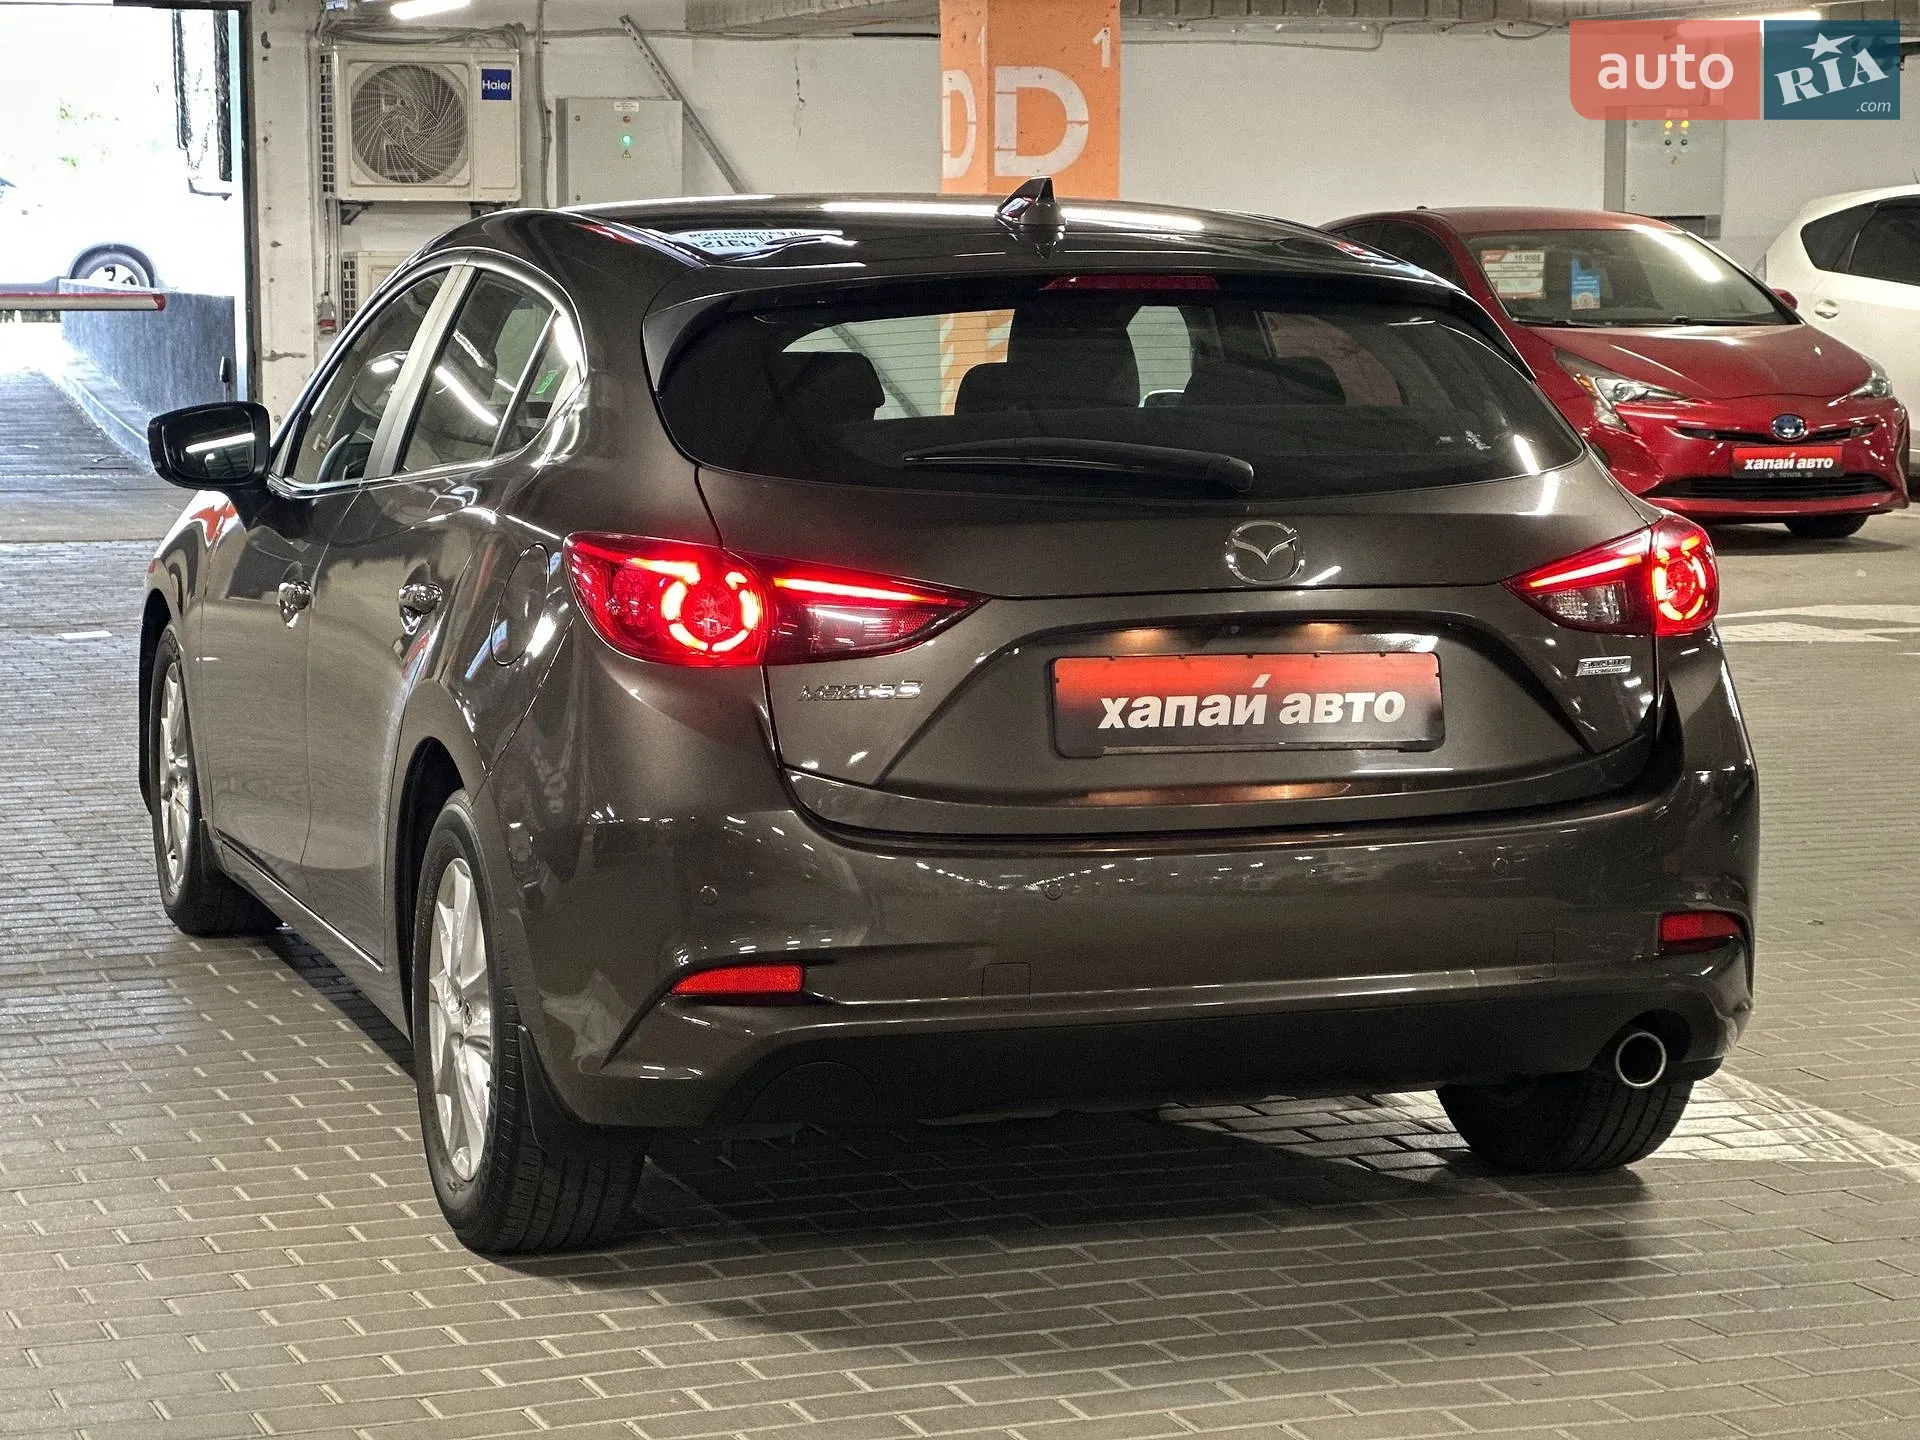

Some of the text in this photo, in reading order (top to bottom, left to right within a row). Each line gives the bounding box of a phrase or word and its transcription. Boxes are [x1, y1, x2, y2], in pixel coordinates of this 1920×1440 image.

[1092, 27, 1112, 68] 1
[482, 80, 511, 90] Haier
[942, 69, 977, 179] D
[994, 66, 1089, 177] D
[1796, 457, 1834, 469] авто
[1279, 691, 1406, 725] авто
